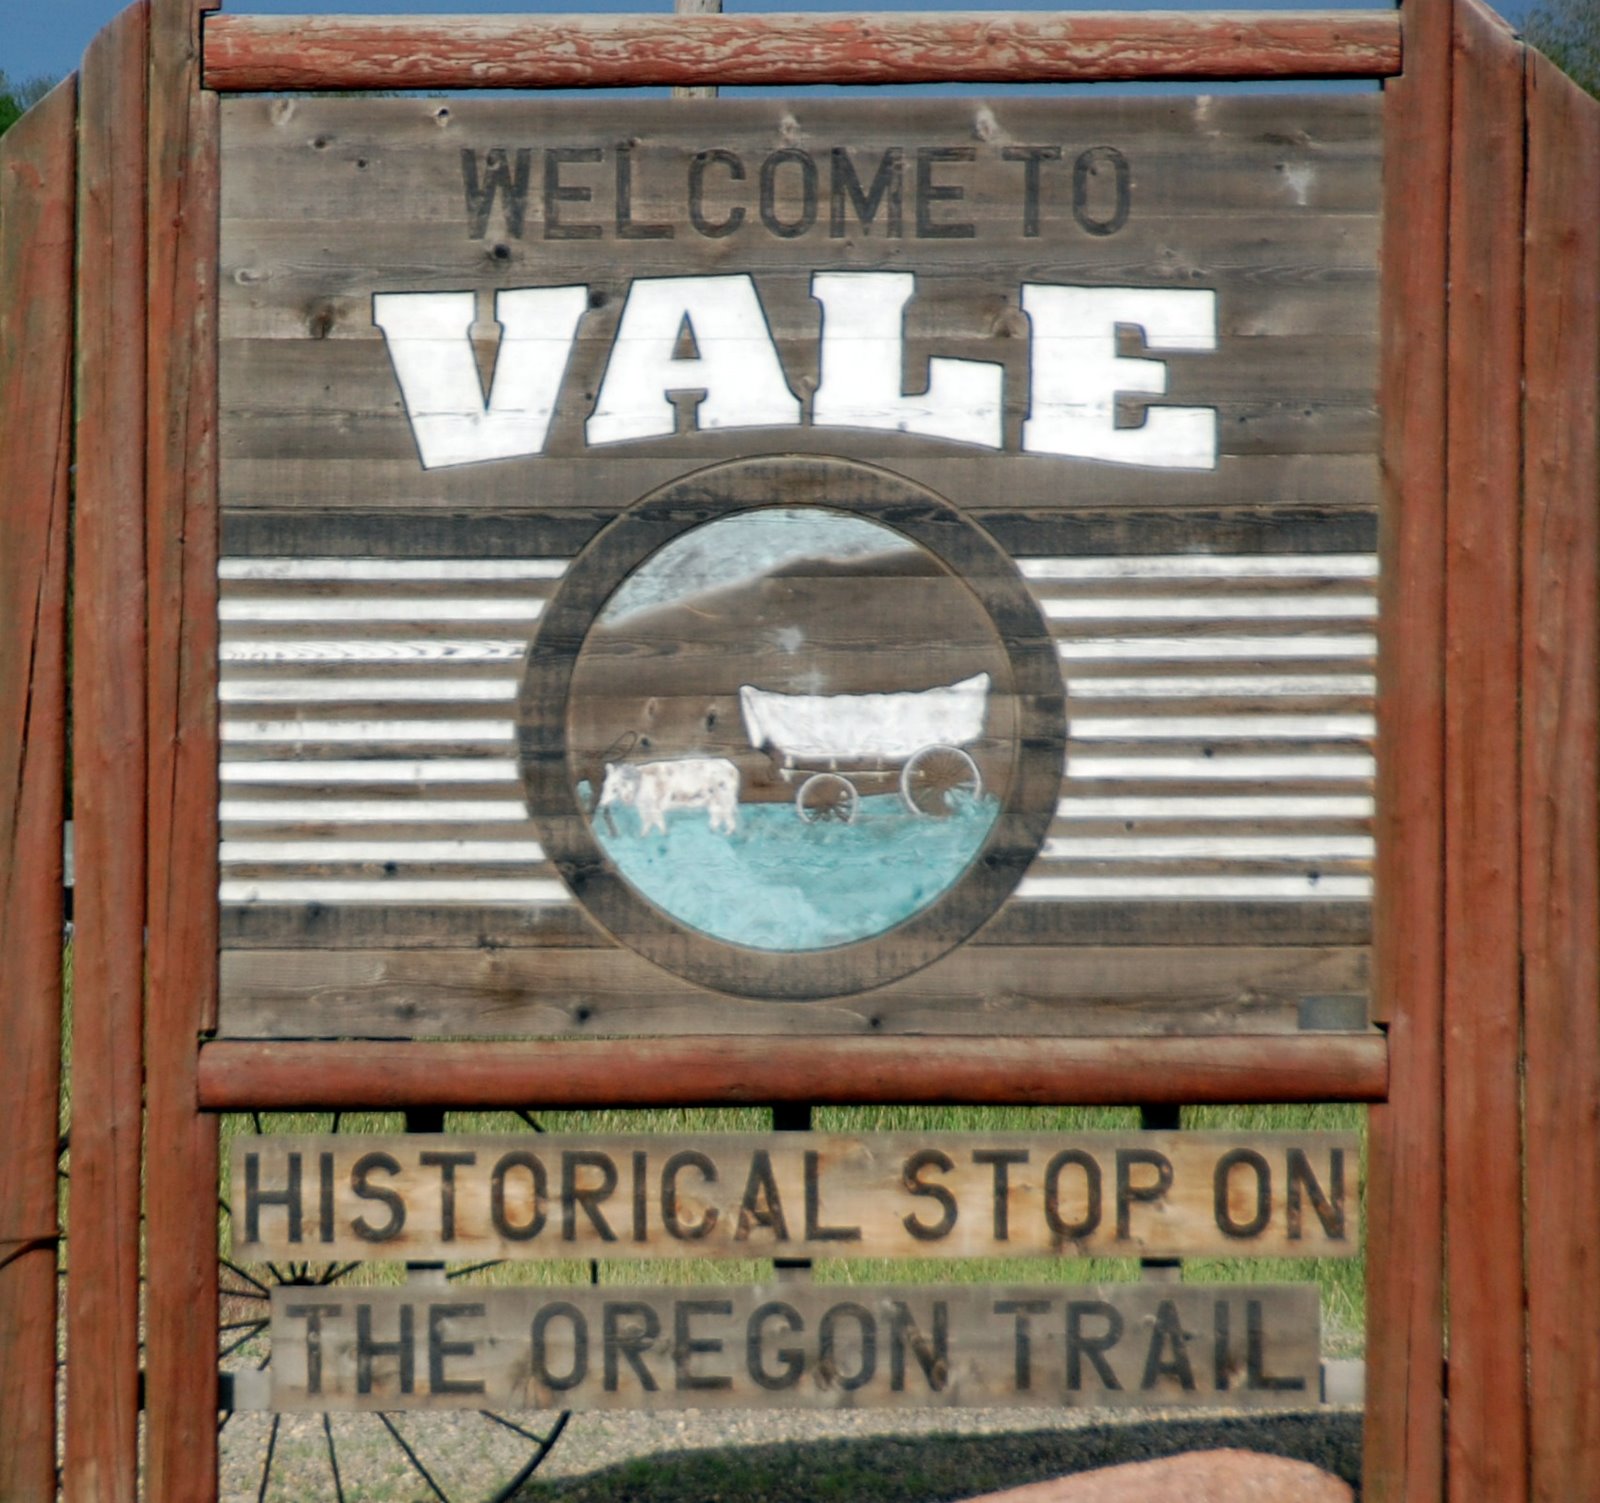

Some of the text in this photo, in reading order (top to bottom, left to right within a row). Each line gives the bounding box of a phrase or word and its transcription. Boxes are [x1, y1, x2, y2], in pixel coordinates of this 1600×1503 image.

[464, 145, 1132, 240] WELCOME TO
[373, 272, 1217, 469] VALE
[244, 1147, 1346, 1243] HISTORICAL STOP ON
[285, 1299, 1307, 1395] THE OREGON TRAIL
